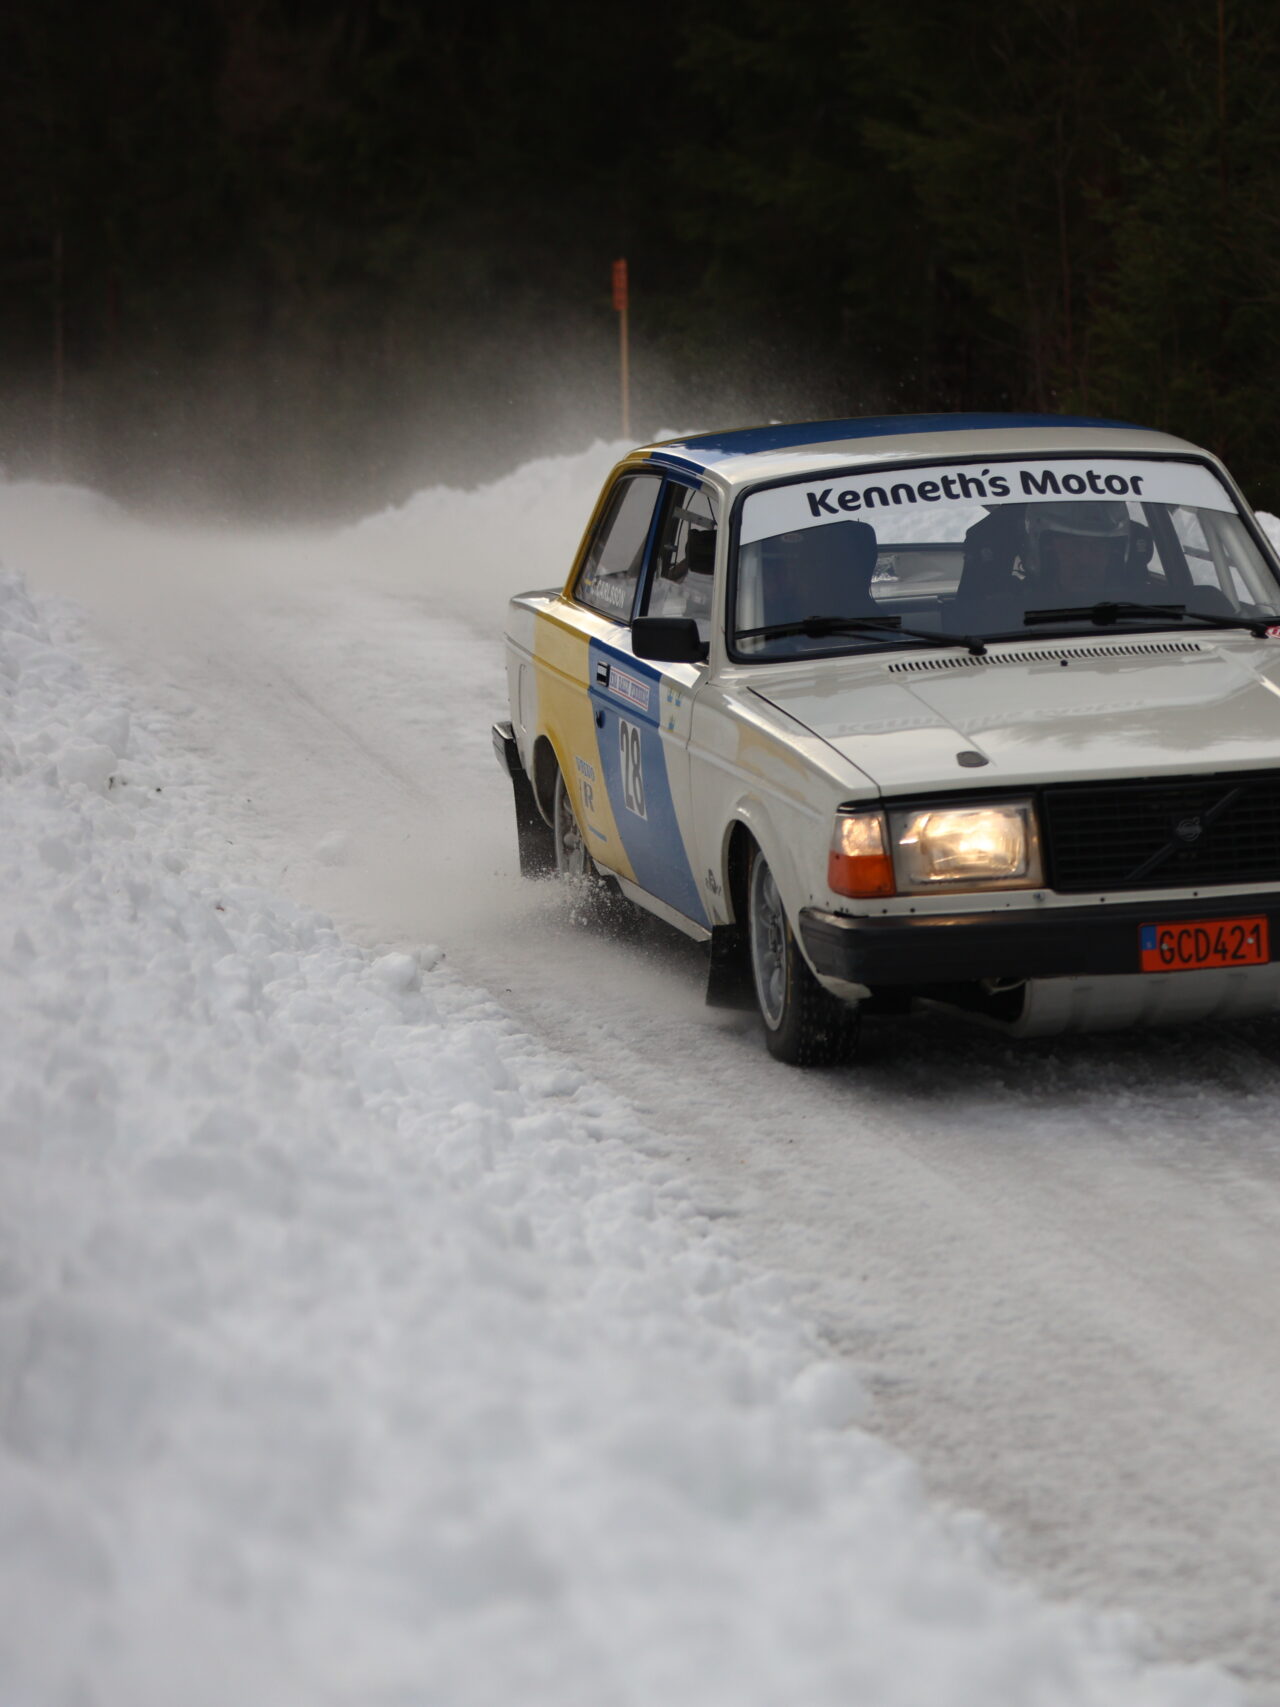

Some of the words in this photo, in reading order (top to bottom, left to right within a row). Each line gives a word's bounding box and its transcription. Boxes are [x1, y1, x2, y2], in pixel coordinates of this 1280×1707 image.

[806, 468, 1011, 517] Kenneth's
[1019, 469, 1144, 496] Motor
[620, 720, 645, 818] 28
[1159, 923, 1262, 965] GCD421
